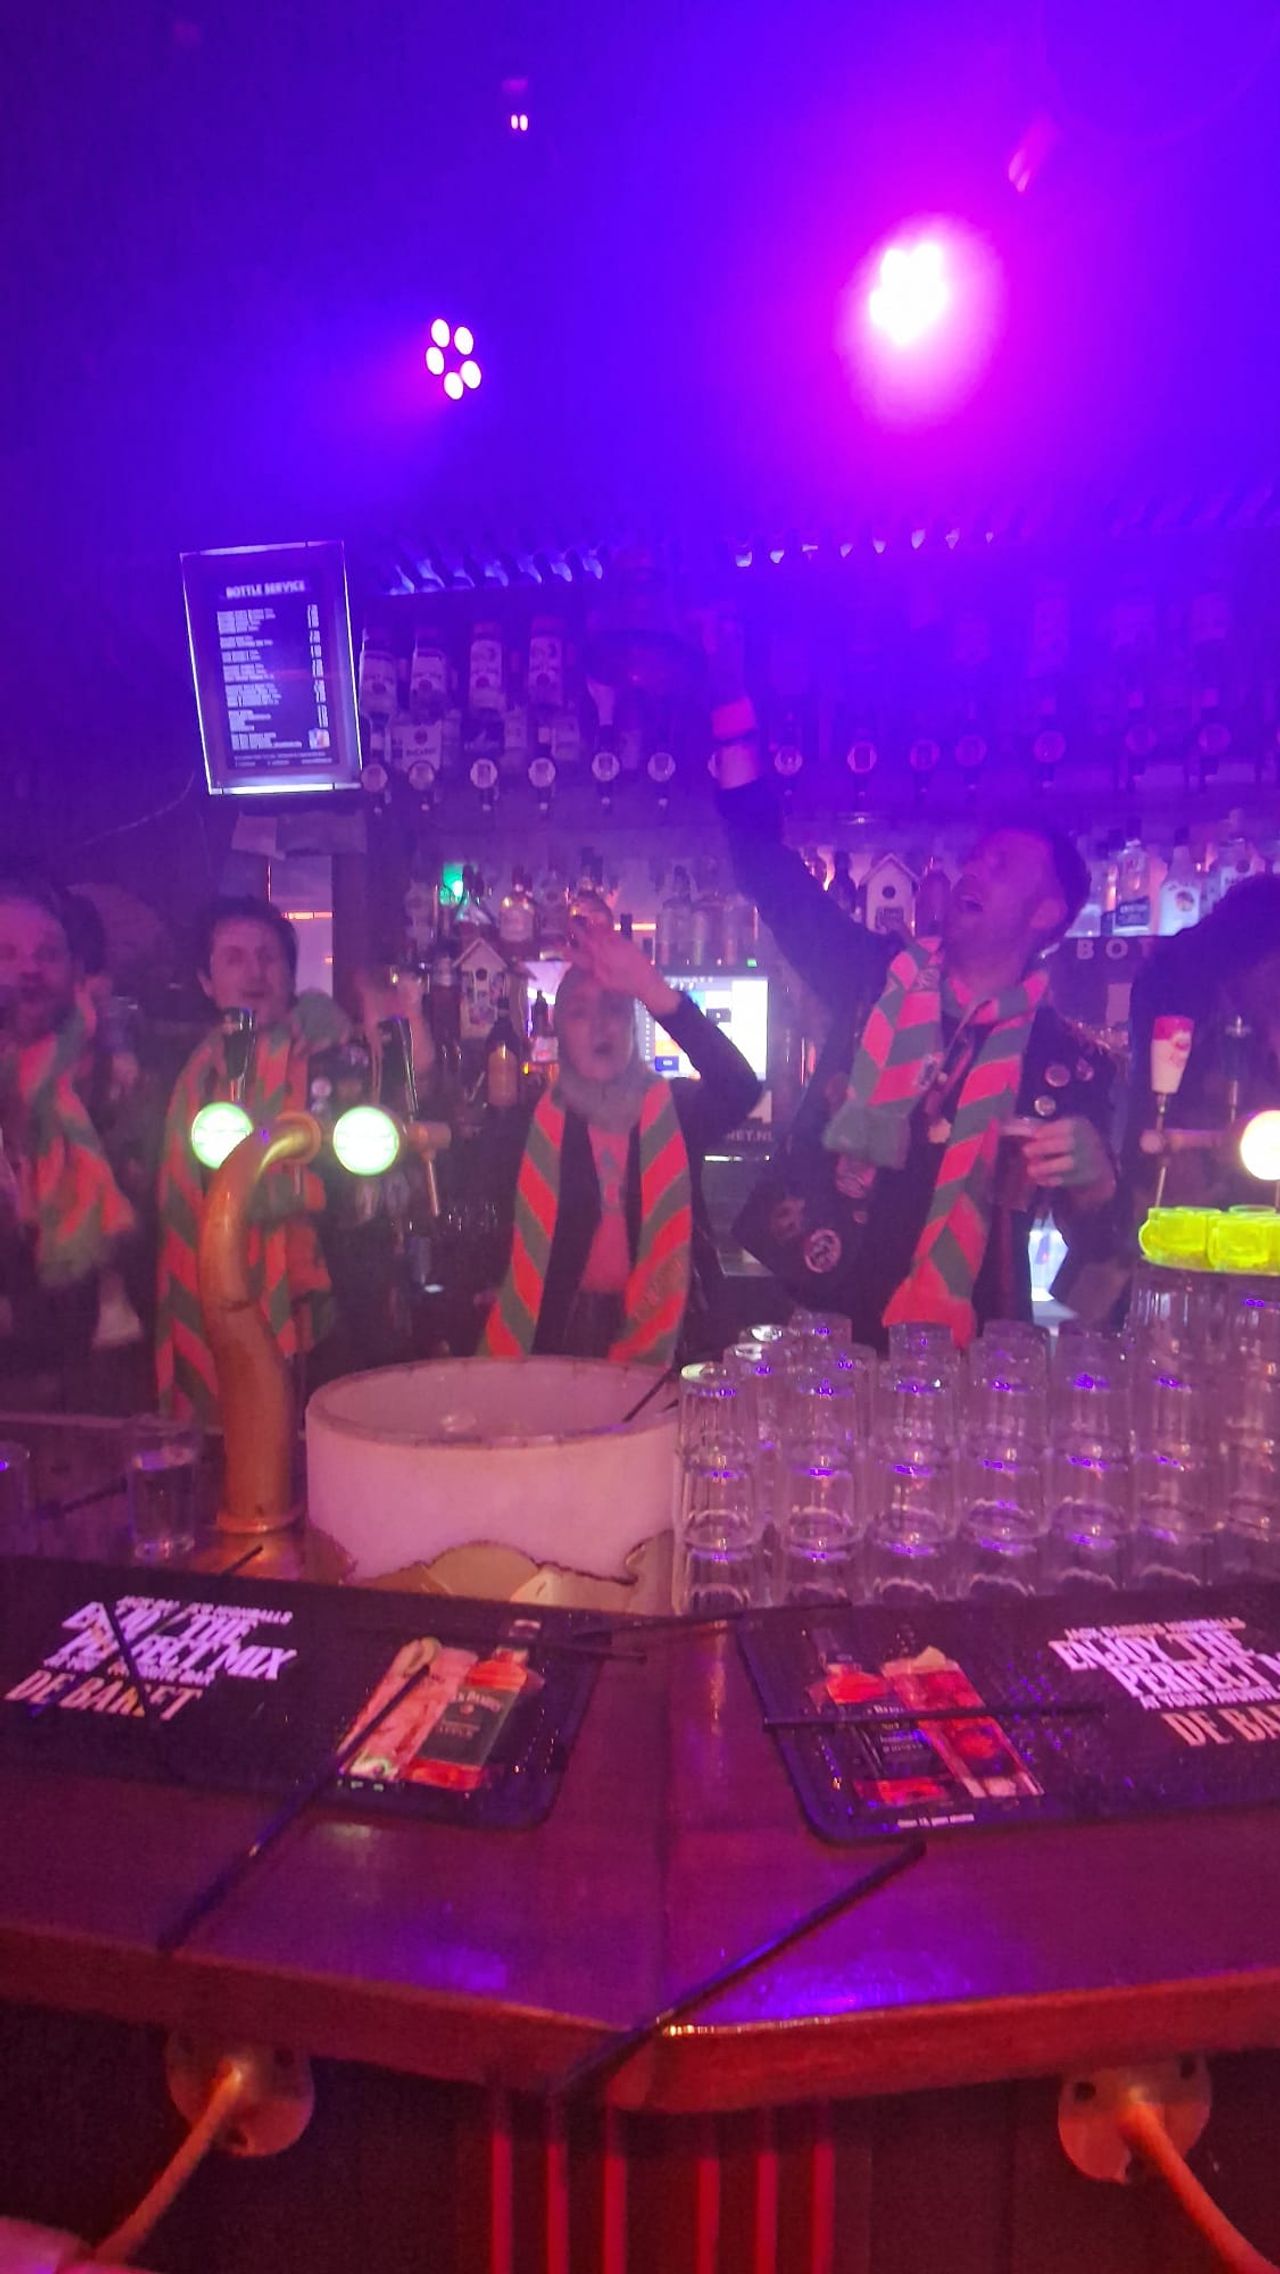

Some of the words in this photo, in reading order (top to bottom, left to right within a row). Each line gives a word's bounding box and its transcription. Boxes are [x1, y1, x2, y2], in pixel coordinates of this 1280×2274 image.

[226, 584, 262, 600] BOTTLE
[264, 580, 305, 596] SERVICE
[1048, 1634, 1173, 1672] ENJOY
[1165, 1629, 1254, 1660] THE
[1106, 1656, 1271, 1698] PERFECT
[1161, 1708, 1234, 1747] DE
